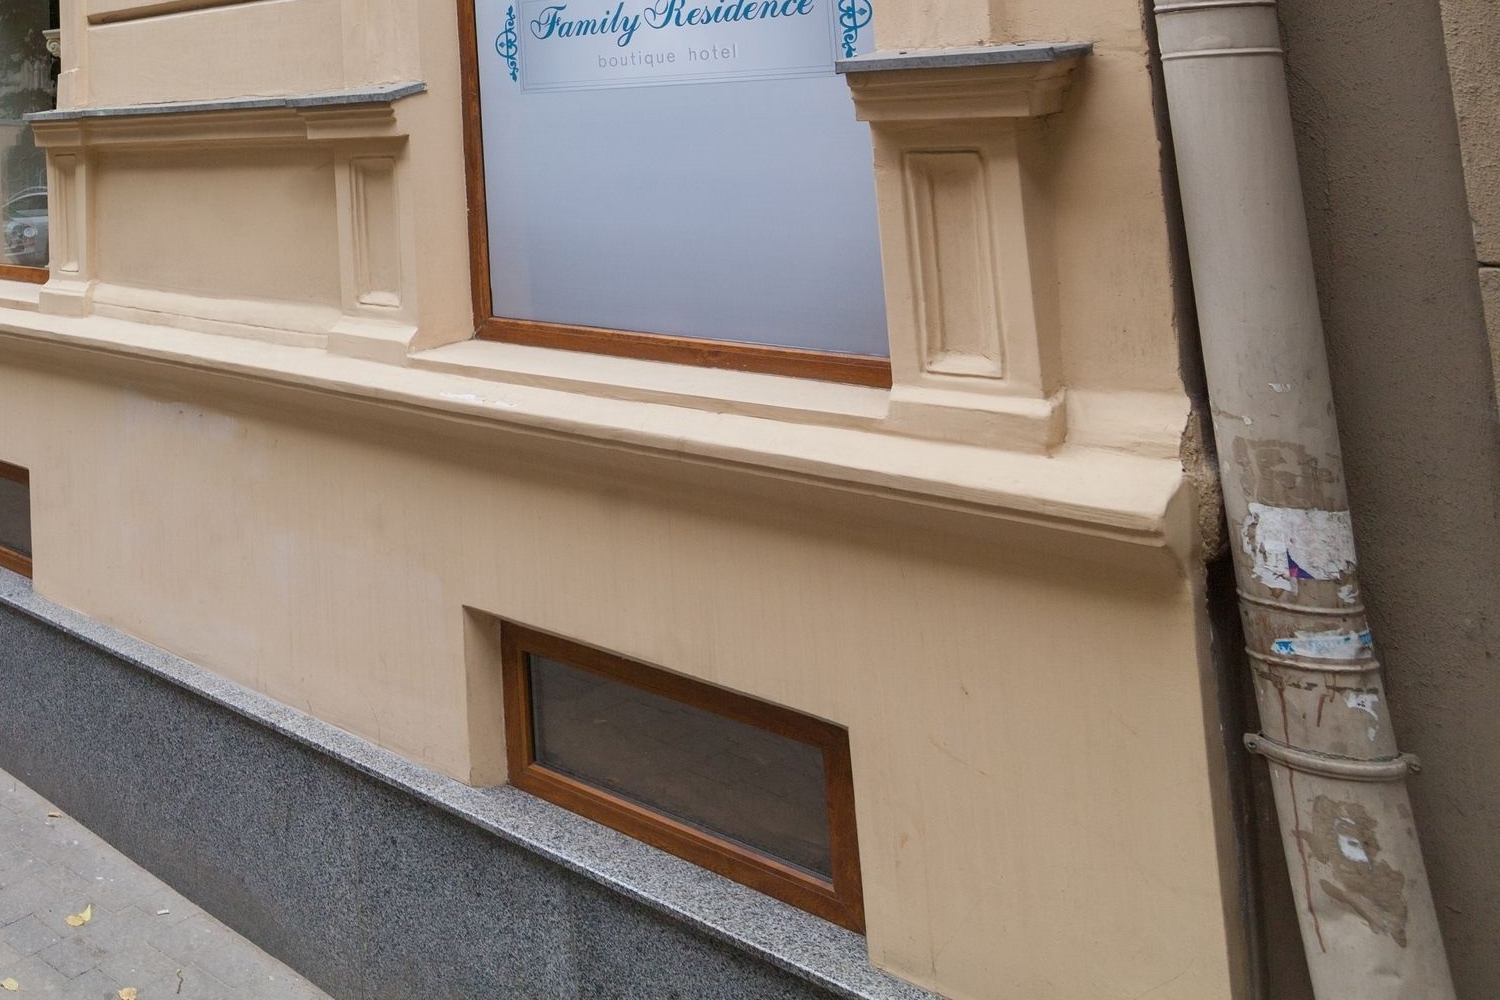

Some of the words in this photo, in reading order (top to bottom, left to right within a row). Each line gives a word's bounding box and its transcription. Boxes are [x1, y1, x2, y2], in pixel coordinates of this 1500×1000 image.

[530, 1, 642, 47] Family
[598, 50, 677, 69] boutique
[689, 43, 738, 62] hotel
